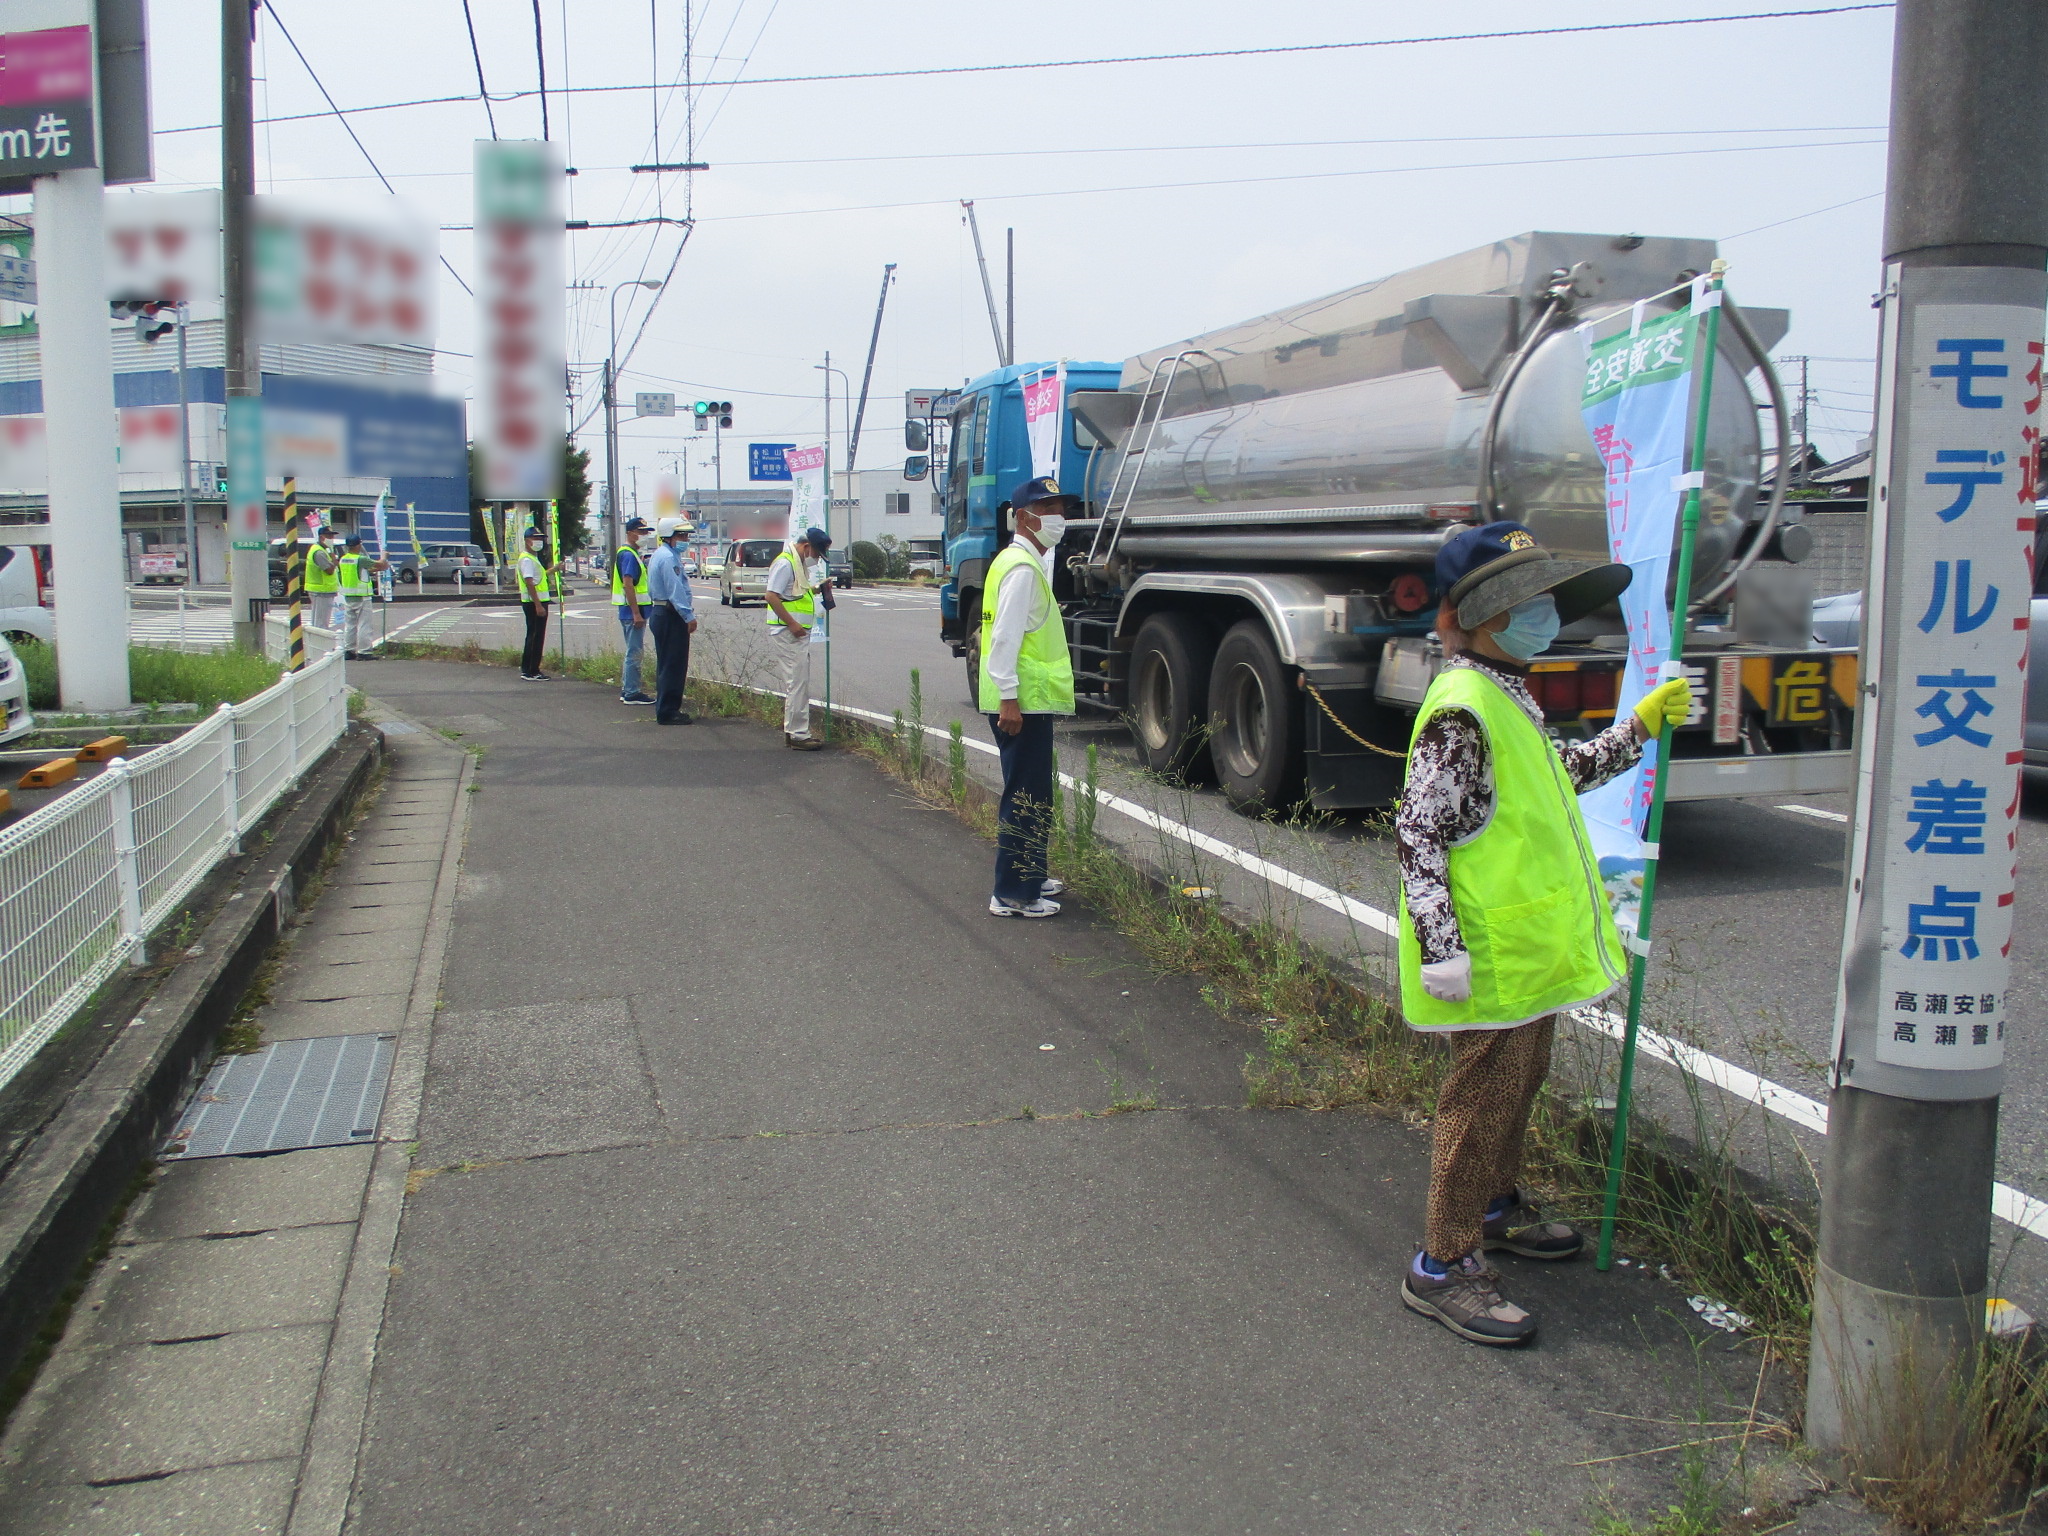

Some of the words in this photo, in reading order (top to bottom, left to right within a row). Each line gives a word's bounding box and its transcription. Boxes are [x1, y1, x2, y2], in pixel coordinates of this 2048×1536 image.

[1898, 339, 2009, 962] モデル交差点
[1775, 660, 1827, 722] 危
[1895, 991, 2008, 1015] 高瀬安協・
